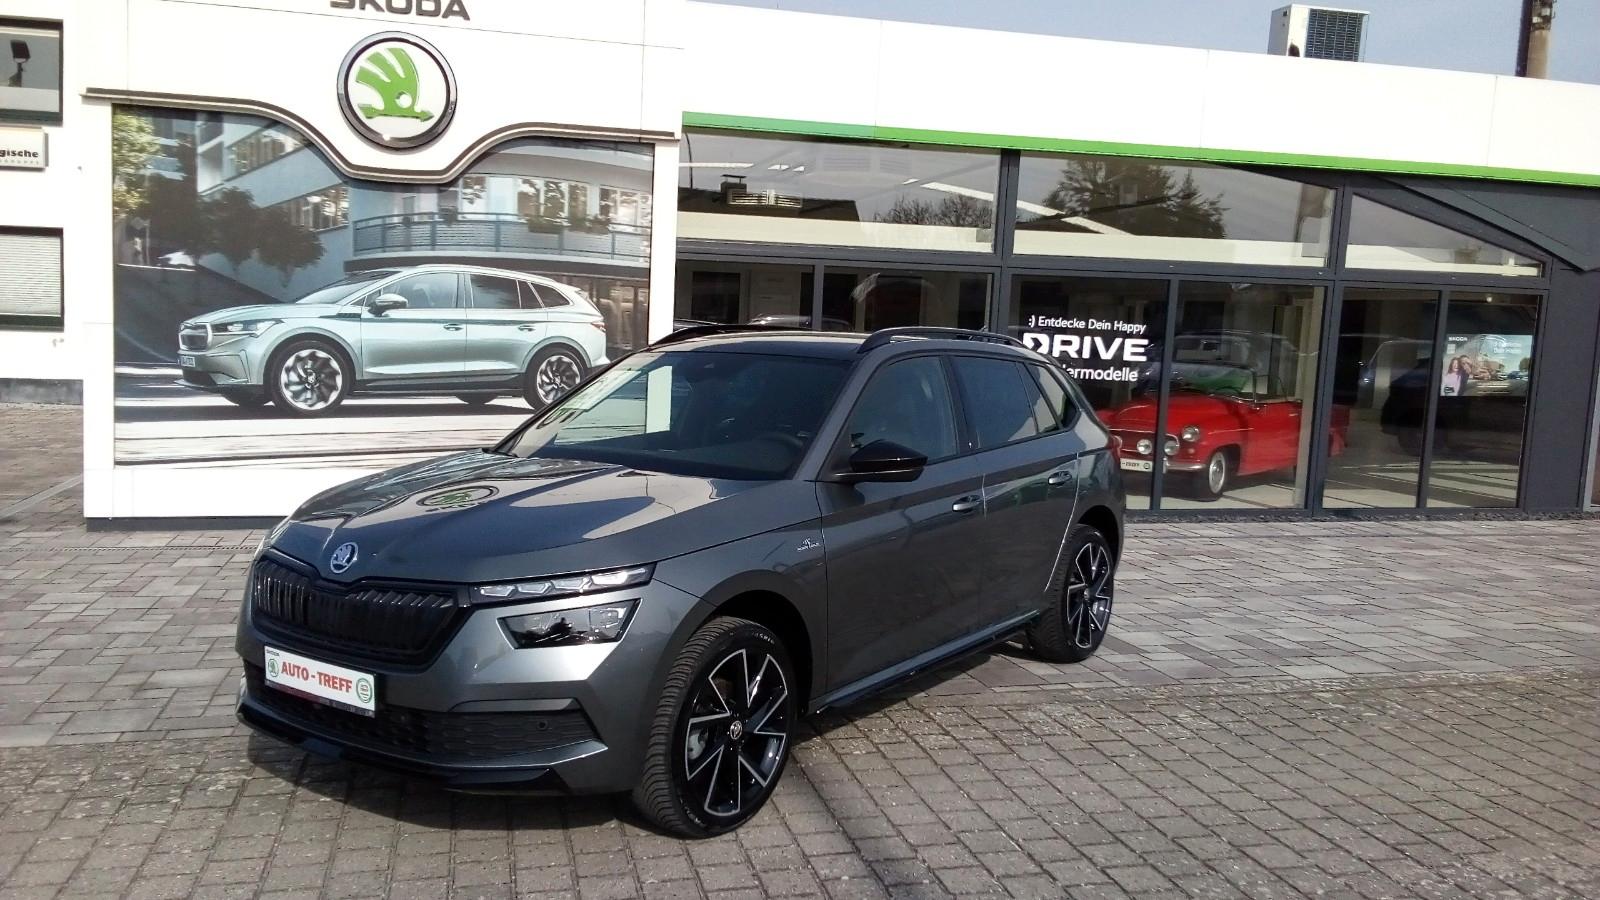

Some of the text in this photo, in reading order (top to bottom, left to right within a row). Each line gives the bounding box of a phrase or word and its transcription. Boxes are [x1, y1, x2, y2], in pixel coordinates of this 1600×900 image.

[1038, 316, 1086, 329] Entdecke
[1088, 319, 1111, 331] Dein
[1113, 320, 1147, 335] Happy
[1022, 332, 1149, 362] DRIVE
[1062, 364, 1139, 382] ermodelle
[281, 661, 309, 681] AUTO
[317, 671, 353, 693] TREFF
